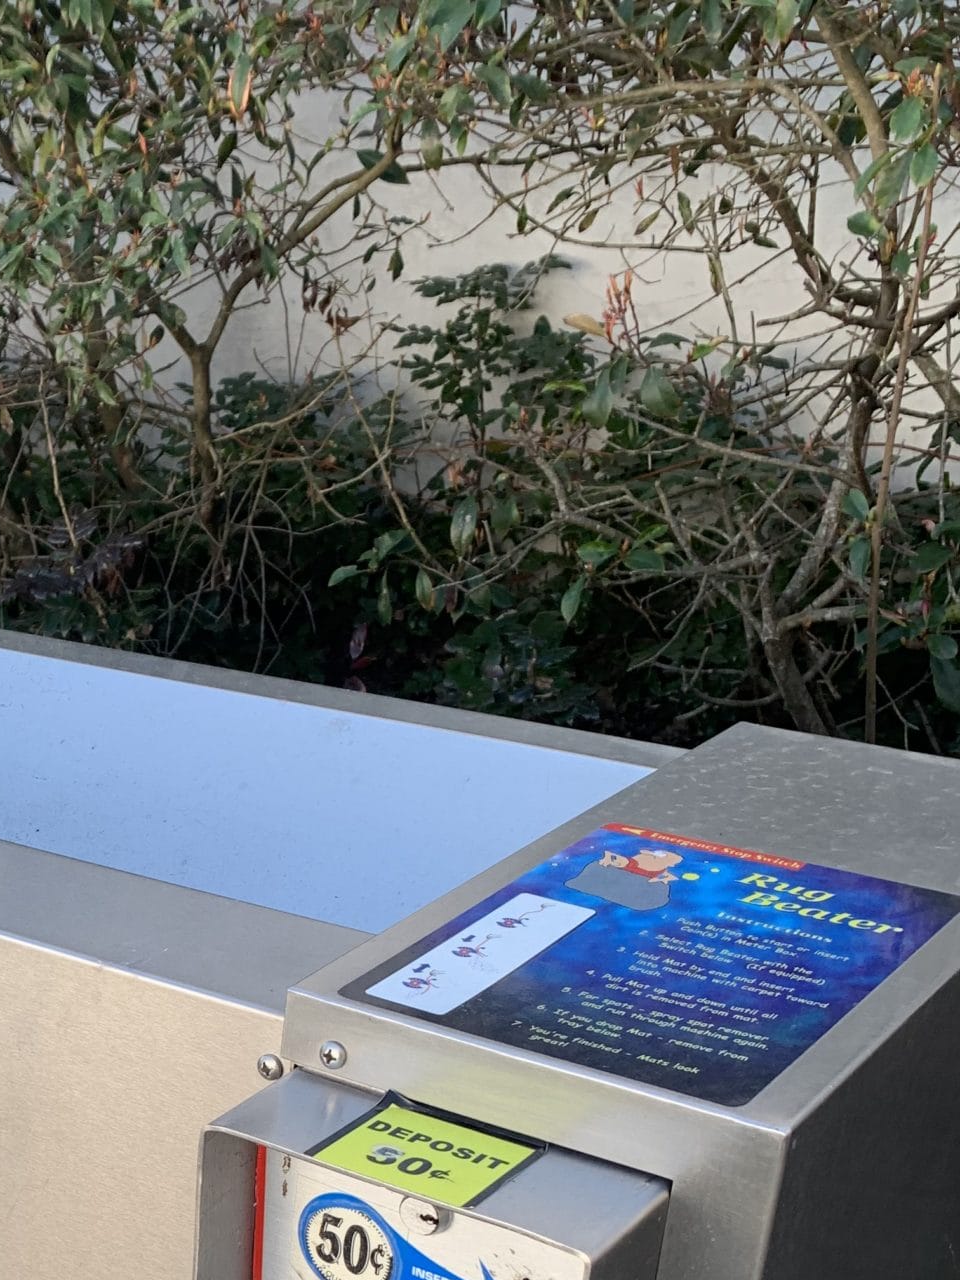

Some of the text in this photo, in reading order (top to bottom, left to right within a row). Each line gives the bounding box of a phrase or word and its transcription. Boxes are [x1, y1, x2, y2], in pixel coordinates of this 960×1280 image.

[651, 832, 801, 869] Emergency Stop Switch
[734, 872, 835, 902] Rug
[718, 911, 832, 943] Instructions
[736, 891, 904, 934] Beater
[655, 935, 692, 946] Select
[695, 943, 716, 954] Rug
[720, 949, 760, 961] Beater
[763, 960, 788, 969] with
[793, 966, 813, 975] the
[677, 917, 701, 927] Push
[705, 924, 743, 936] Button
[763, 939, 793, 948] start
[814, 950, 850, 961] insert
[735, 939, 771, 950] Meter
[633, 950, 660, 961] Hold
[662, 958, 686, 968] Mat
[689, 964, 705, 973] by
[708, 970, 731, 978] end
[733, 976, 756, 984] and
[759, 981, 795, 992] insert
[636, 959, 830, 1009] into machine with carpet toward
[659, 943, 696, 955] Switch
[746, 963, 767, 972] (If
[769, 969, 826, 986] equipped)
[578, 991, 599, 1000] For
[602, 999, 634, 1010] spots
[649, 1010, 683, 1022] spray
[686, 1019, 714, 1029] spot
[718, 1026, 769, 1041] remover
[602, 973, 624, 983] Pull
[625, 980, 650, 990] Mat
[671, 992, 695, 1000] and
[696, 997, 726, 1008] down
[730, 1005, 759, 1016] until
[761, 1012, 778, 1020] all
[605, 983, 629, 992] dirt
[645, 993, 698, 1009] removed
[699, 1005, 729, 1017] from
[732, 1014, 759, 1024] mat.
[528, 1034, 569, 1047] great!
[553, 1008, 570, 1016] If
[570, 1014, 592, 1023] you
[596, 1020, 623, 1031] drop
[626, 1028, 653, 1038] Mat
[668, 1039, 714, 1053] remove
[718, 1049, 749, 1062] from
[557, 1018, 622, 1039] tray below.
[581, 1001, 769, 1051] and run through machine again.
[529, 1024, 568, 1040] You're
[571, 1037, 623, 1054] finished
[636, 1054, 670, 1067] Mats
[673, 1062, 700, 1074] look
[366, 1119, 509, 1171] DEPOSIT
[366, 1144, 455, 1184] 50¢
[315, 1213, 386, 1276] 50¢
